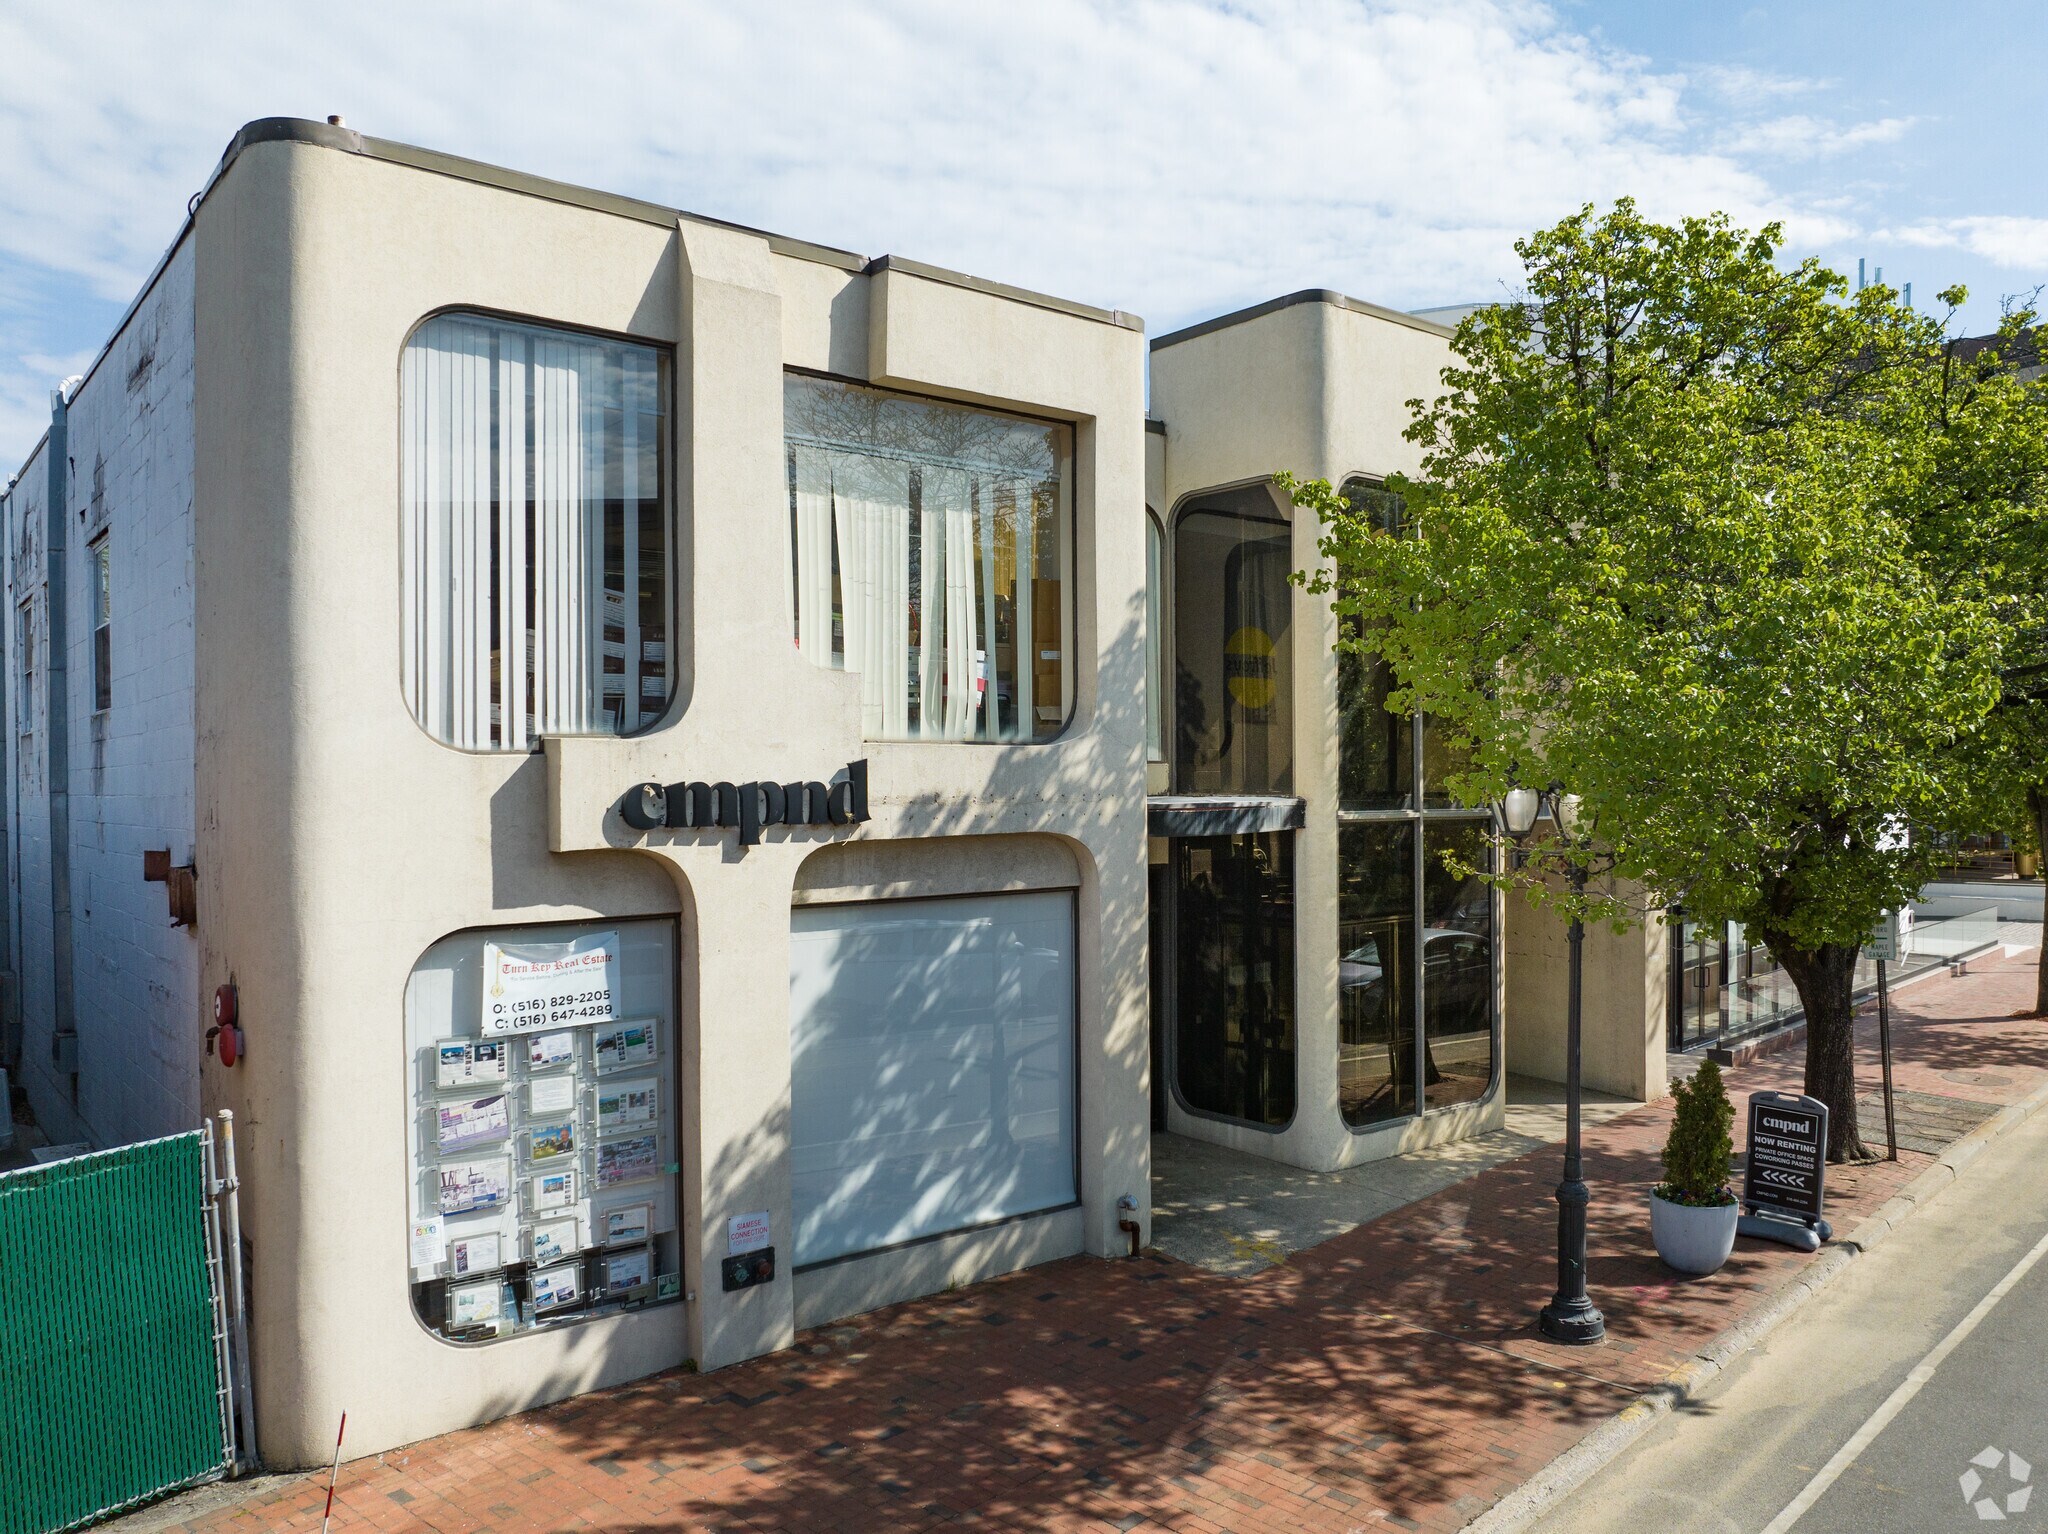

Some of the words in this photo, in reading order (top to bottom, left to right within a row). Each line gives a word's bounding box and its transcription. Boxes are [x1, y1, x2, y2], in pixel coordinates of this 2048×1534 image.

[621, 759, 871, 845] cmpnd
[502, 964, 528, 975] Turn
[531, 962, 551, 974] Key
[555, 959, 579, 970] Real
[582, 953, 613, 965] Estate
[493, 1003, 507, 1014] O:
[512, 998, 546, 1013] (516)
[550, 990, 611, 1007] 829-2205
[495, 1019, 508, 1029] C:
[514, 1013, 547, 1028] (516)
[551, 1004, 613, 1022] 647-4289
[1762, 1116, 1810, 1134] cmpnd
[1754, 1135, 1775, 1146] NOW
[1777, 1140, 1816, 1154] RENTING
[1754, 1153, 1791, 1165] COWORKING
[1791, 1159, 1815, 1170] PASSES
[1755, 1146, 1777, 1156] PRIVATE
[1777, 1151, 1796, 1160] OFFICE
[1796, 1154, 1815, 1163] SPACE
[731, 1227, 768, 1240] CONNECTION
[736, 1220, 761, 1230] SIAMESE
